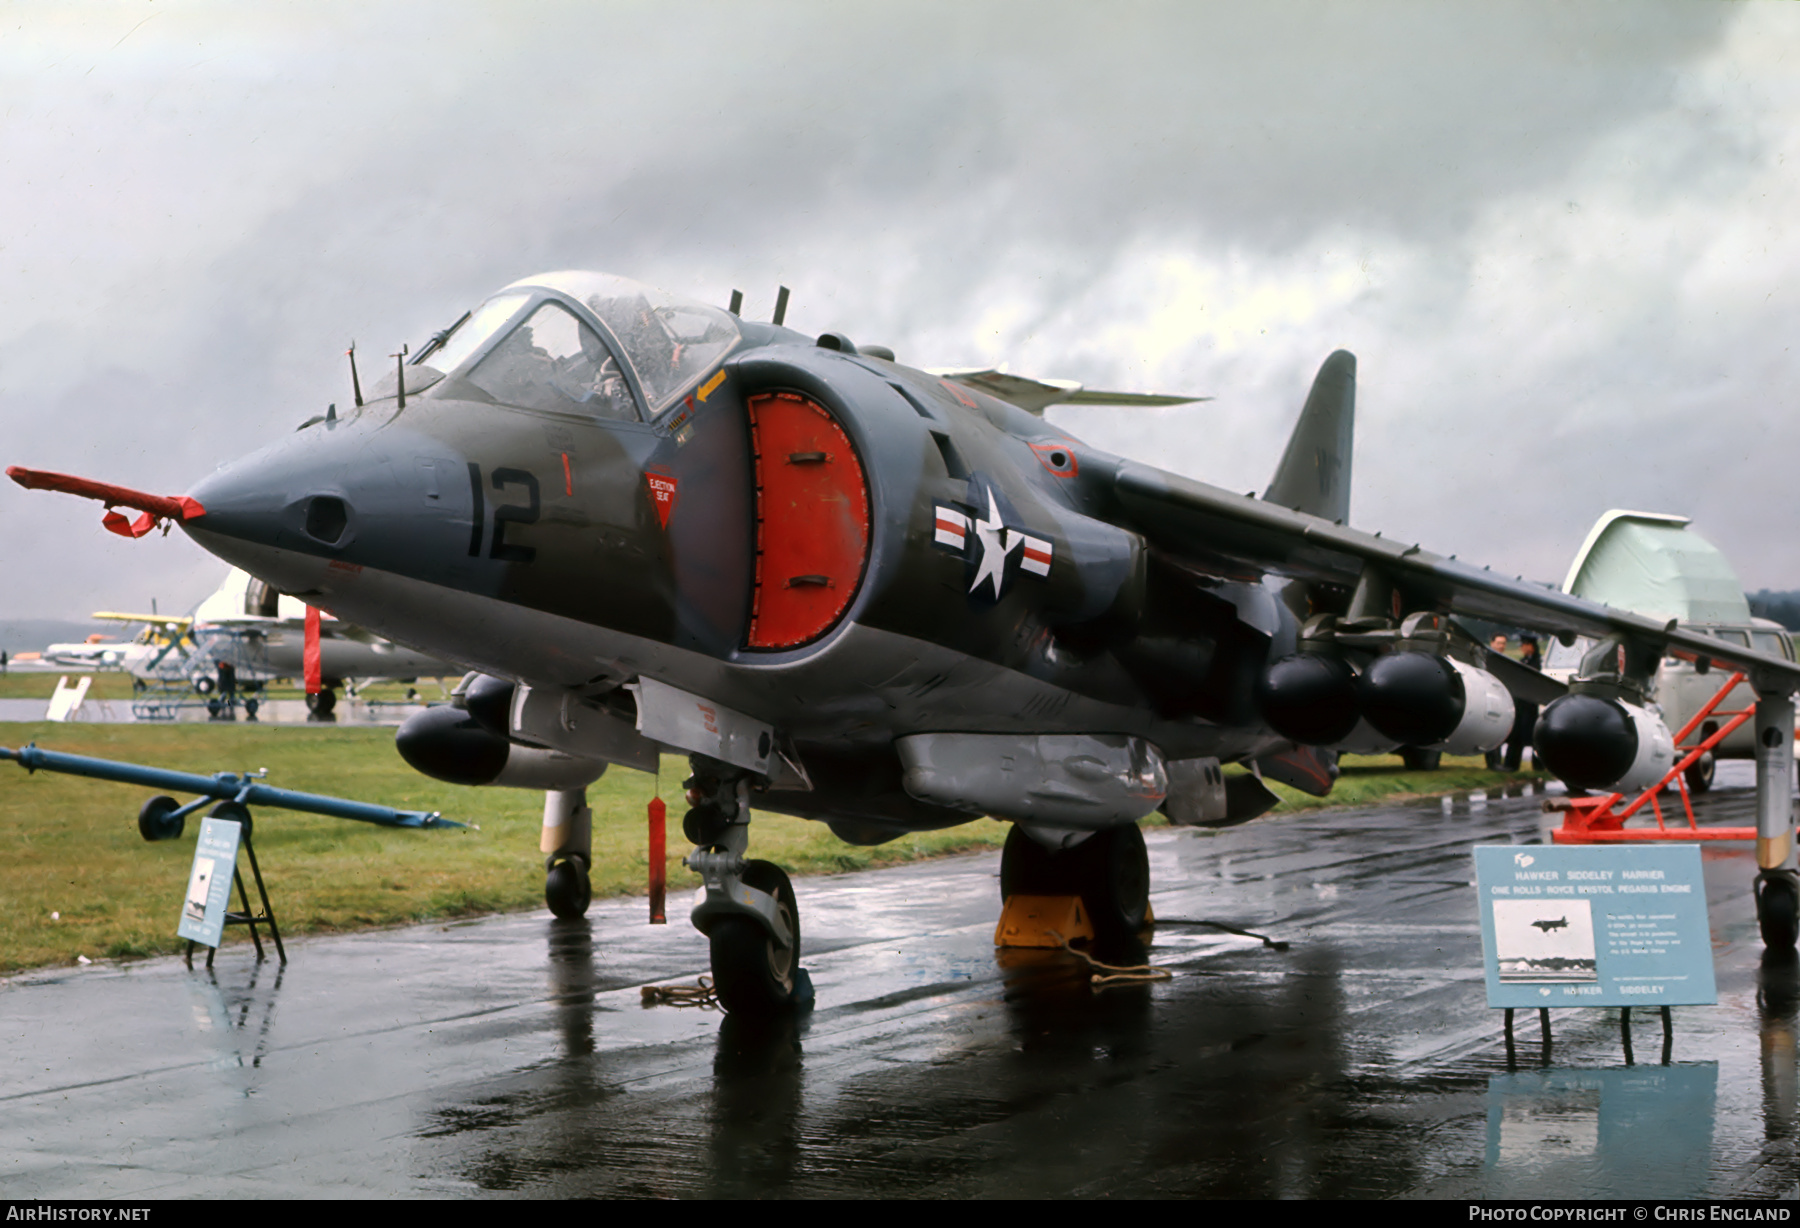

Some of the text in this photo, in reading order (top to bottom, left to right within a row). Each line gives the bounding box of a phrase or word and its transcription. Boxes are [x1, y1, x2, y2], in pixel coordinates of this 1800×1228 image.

[649, 478, 676, 492] EJECTION
[656, 490, 669, 502] SEAT
[467, 462, 540, 562] 12
[1514, 870, 1665, 881] HAWKER SIDDELEY HARRIER
[1491, 885, 1510, 895] ONE
[1577, 885, 1615, 895] BRISTOL
[1618, 884, 1658, 894] PEGASUS
[1660, 884, 1691, 893] ENGINE
[1563, 985, 1664, 996] HAWKER SIDDELEY
